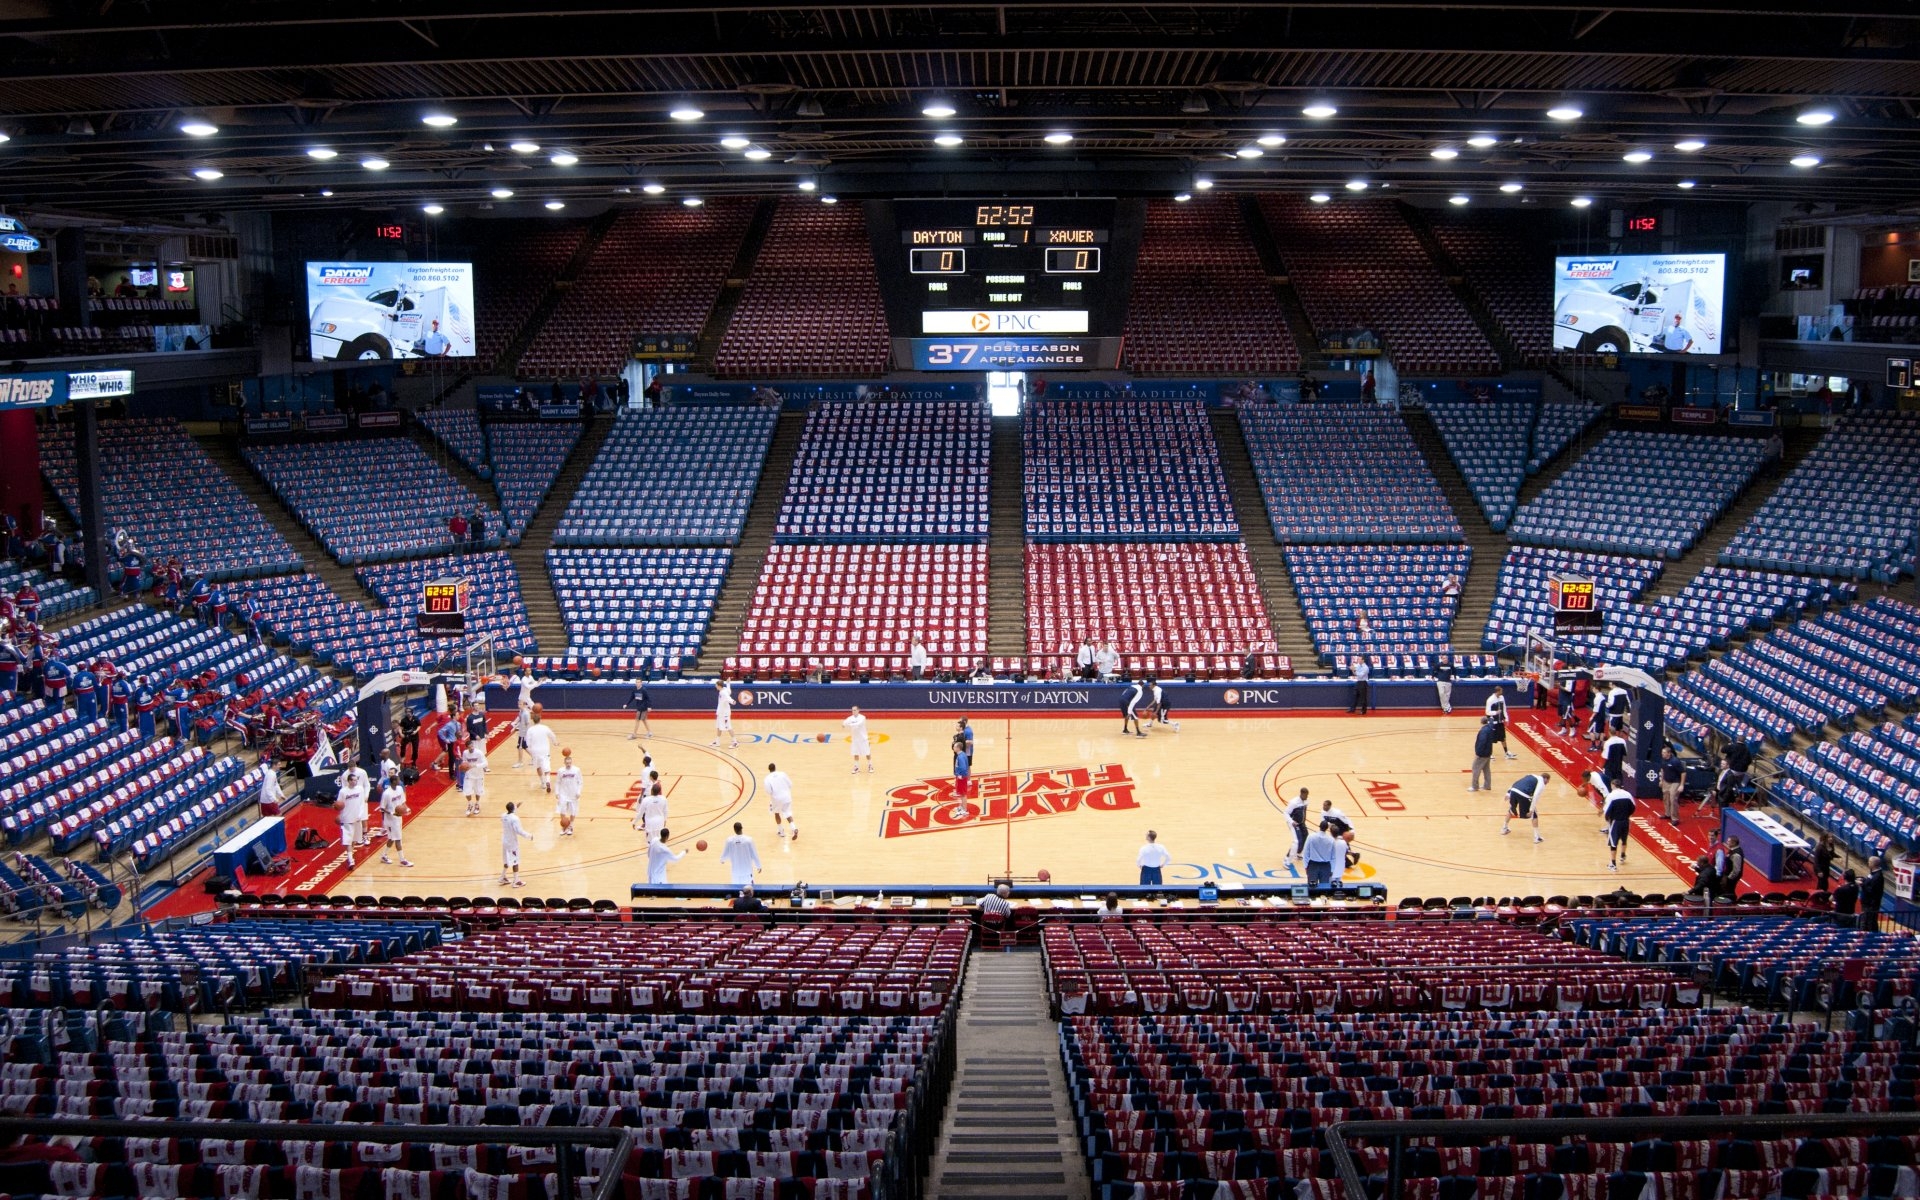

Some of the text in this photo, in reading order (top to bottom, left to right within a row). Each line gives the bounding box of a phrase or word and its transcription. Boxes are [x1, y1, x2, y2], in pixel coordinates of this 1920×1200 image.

[976, 206, 1034, 225] 62:52
[1630, 218, 1656, 230] 11:52
[376, 226, 402, 238] 11:52
[913, 231, 962, 243] DAYTON
[983, 232, 1005, 241] PERIOD
[1050, 230, 1094, 242] XAVIER
[940, 251, 953, 270] 0
[1075, 251, 1088, 269] 0
[1572, 260, 1616, 271] DAYTON
[325, 267, 371, 277] DAYTON
[985, 275, 1025, 283] POSSESSION
[928, 282, 948, 291] FOULS
[1062, 281, 1082, 290] FOULS
[989, 293, 1022, 302] TIME OUT
[997, 314, 1041, 331] PNC
[928, 345, 978, 364] 37
[71, 375, 97, 384] WHIO
[12, 379, 54, 402] FLYERS
[99, 380, 123, 393] WHIO
[783, 391, 861, 400] UNIVERSITY
[891, 390, 943, 399] DAYTON
[1120, 390, 1207, 398] TRADITION
[426, 586, 455, 596] 62:52
[1562, 584, 1592, 593] 62:52
[432, 598, 451, 611] 00
[1567, 595, 1587, 608] 00
[756, 691, 793, 705] PNC
[928, 691, 1089, 704] UNIVERSITY of DAYTON
[1242, 689, 1279, 704] PNC
[735, 733, 832, 744] PNC
[1546, 747, 1575, 764] Court
[1357, 779, 1406, 811] A10
[885, 764, 1140, 839] DAYTON FLYERS
[1629, 817, 1683, 853] University
[1172, 863, 1307, 879] PNC
